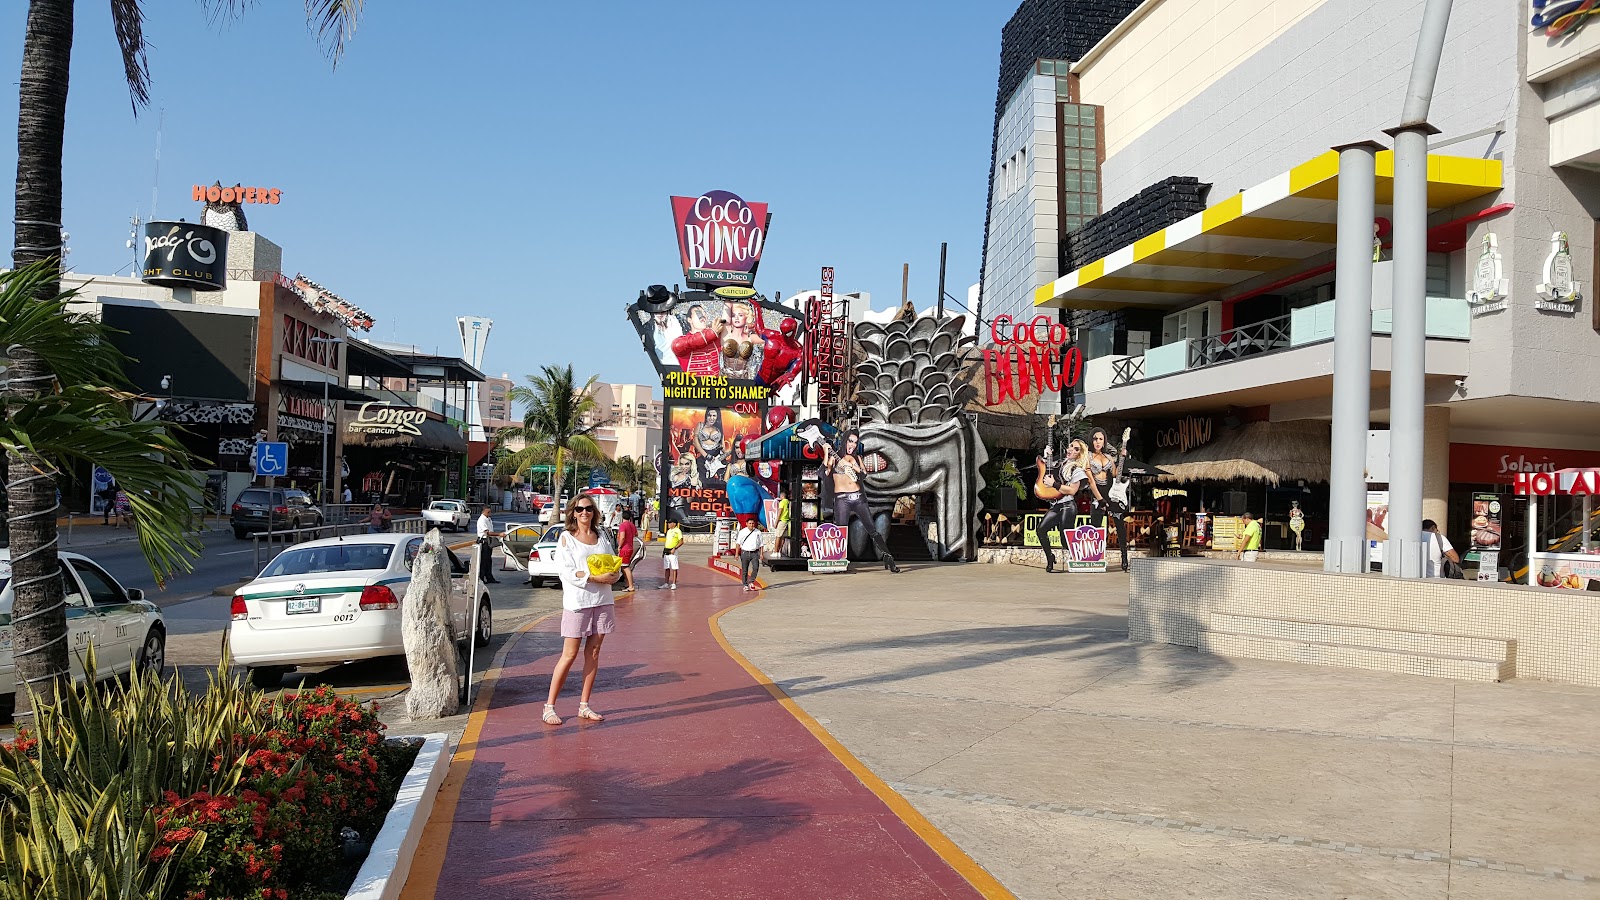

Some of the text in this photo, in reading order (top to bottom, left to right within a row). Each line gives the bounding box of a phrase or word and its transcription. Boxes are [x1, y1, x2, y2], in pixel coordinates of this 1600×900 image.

[192, 184, 281, 204] HOOTERS
[694, 196, 752, 225] CoCo
[685, 219, 763, 269] BONGO
[172, 268, 213, 280] CLUB
[693, 270, 748, 281] Show & Disco
[721, 287, 749, 295] cancun
[991, 313, 1067, 347] CoCo
[832, 316, 846, 385] ROCK
[700, 375, 729, 387] VEGAS
[980, 343, 1083, 407] BONGO
[664, 386, 711, 399] NIGHTLIFE
[714, 387, 727, 399] TO
[357, 401, 427, 435] Congo
[734, 402, 758, 414] CNN
[1178, 415, 1212, 454] BONGO
[1497, 454, 1556, 474] Solaris
[668, 488, 730, 498] MONST
[812, 536, 847, 561] BONGO
[1071, 539, 1106, 562] BONGO
[333, 614, 354, 623] 0012
[75, 631, 91, 646] 5073
[115, 625, 128, 638] TAXI
